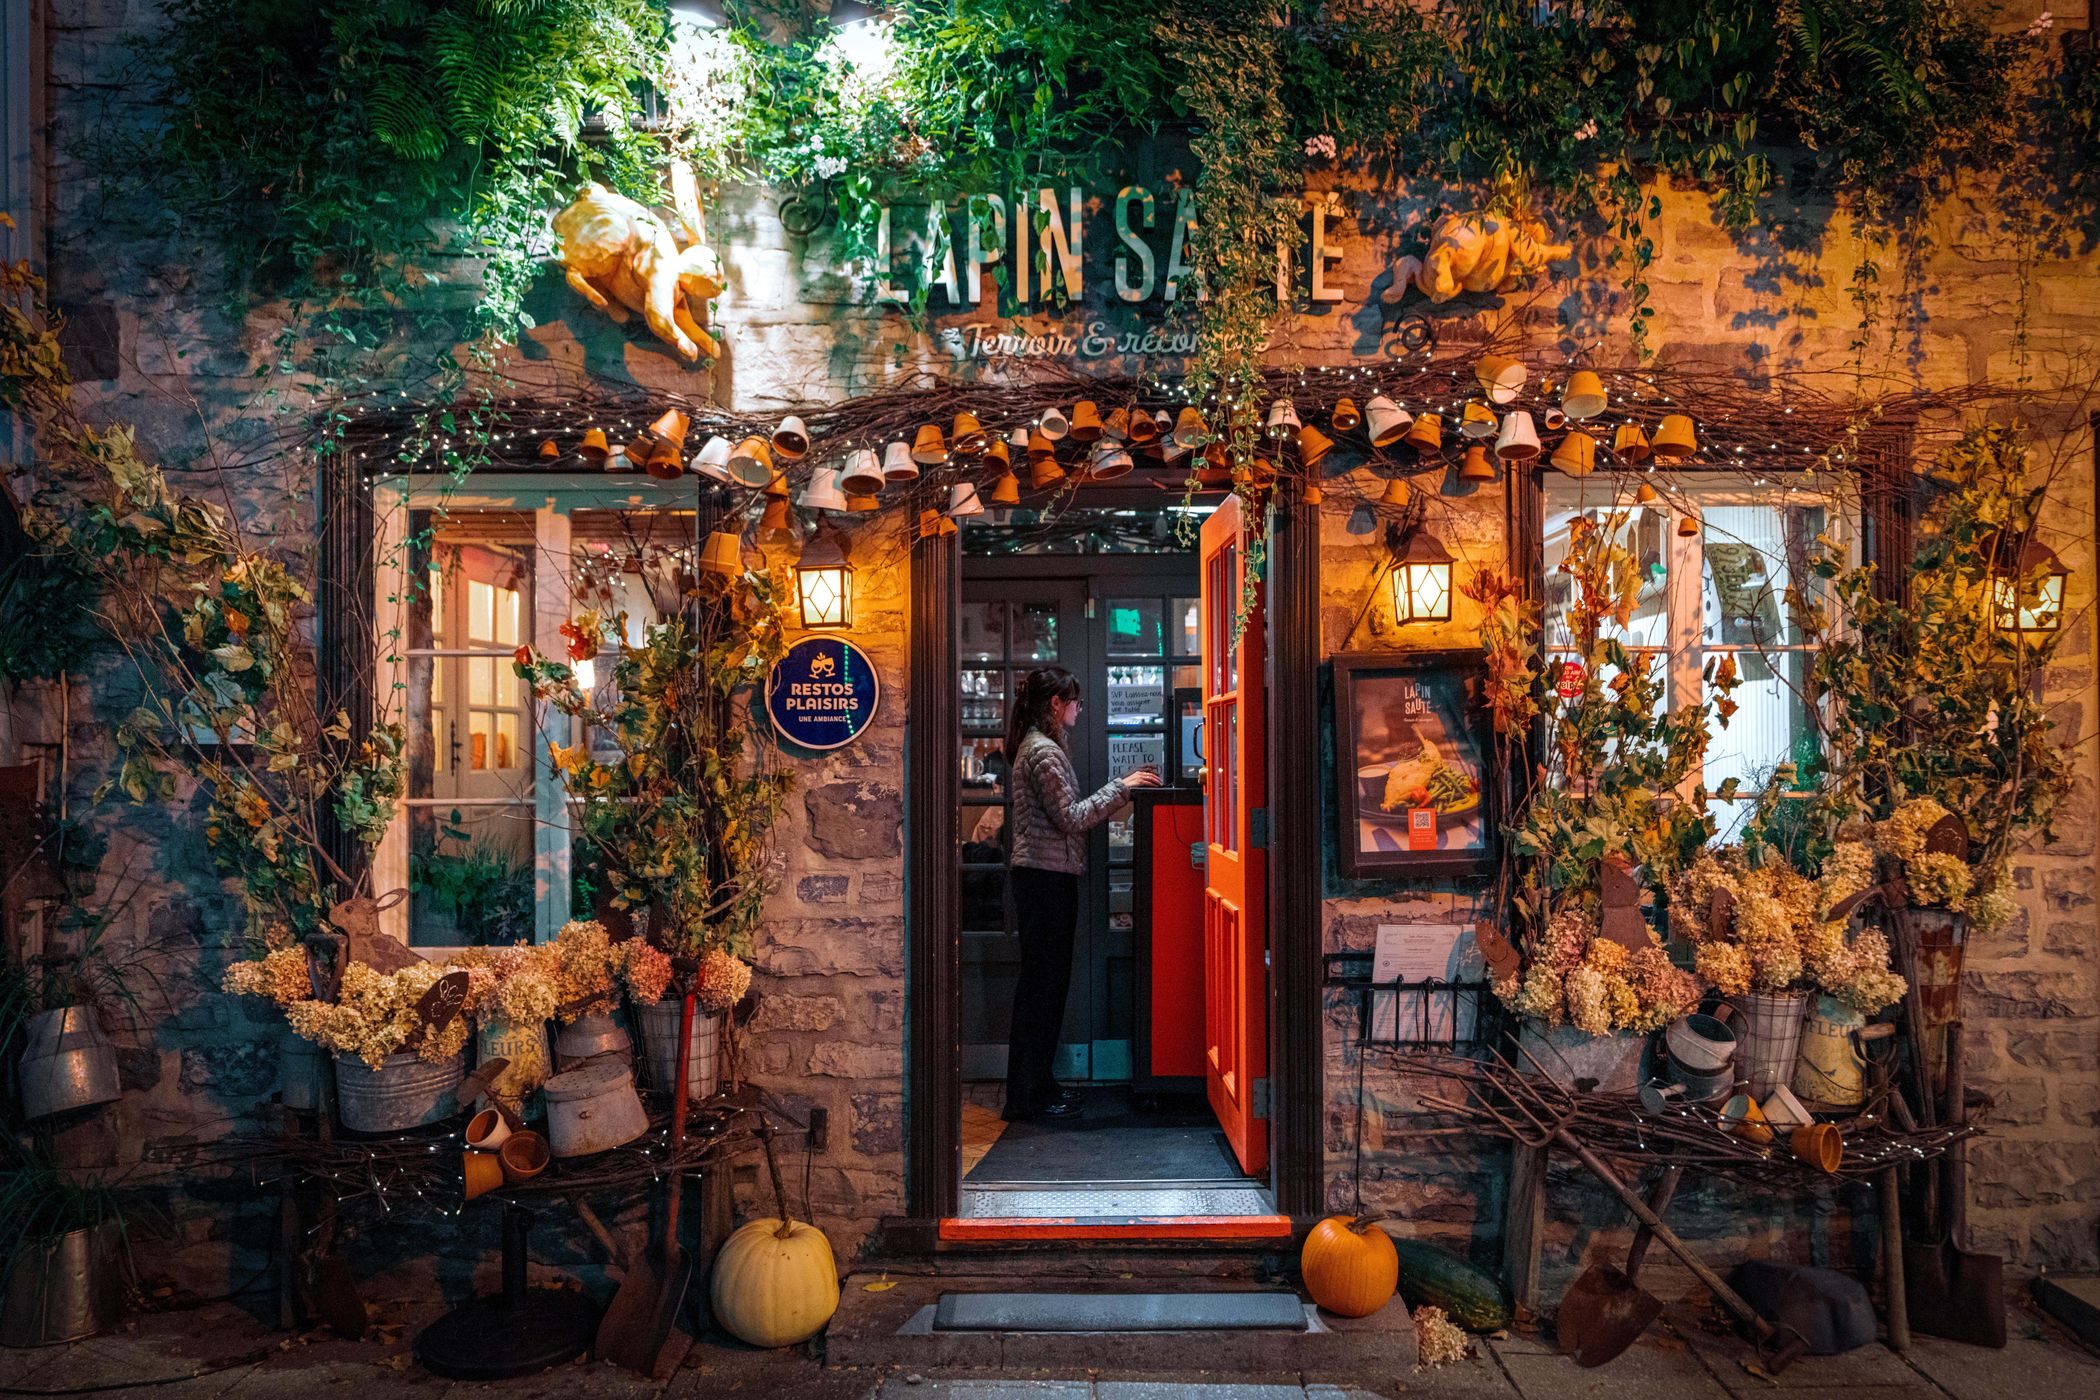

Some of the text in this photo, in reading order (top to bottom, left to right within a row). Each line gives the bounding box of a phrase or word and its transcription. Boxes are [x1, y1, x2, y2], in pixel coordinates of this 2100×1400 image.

[877, 185, 1345, 305] LAPIN SATÉ
[963, 322, 1077, 358] Terroir
[1082, 321, 1115, 357] &
[791, 684, 854, 696] RESTOS
[1404, 682, 1431, 699] LAPIN
[786, 698, 858, 710] PLAISIRS
[1112, 742, 1146, 752] PLEASE
[1112, 754, 1155, 764] WAIT TO
[1112, 766, 1124, 776] BE
